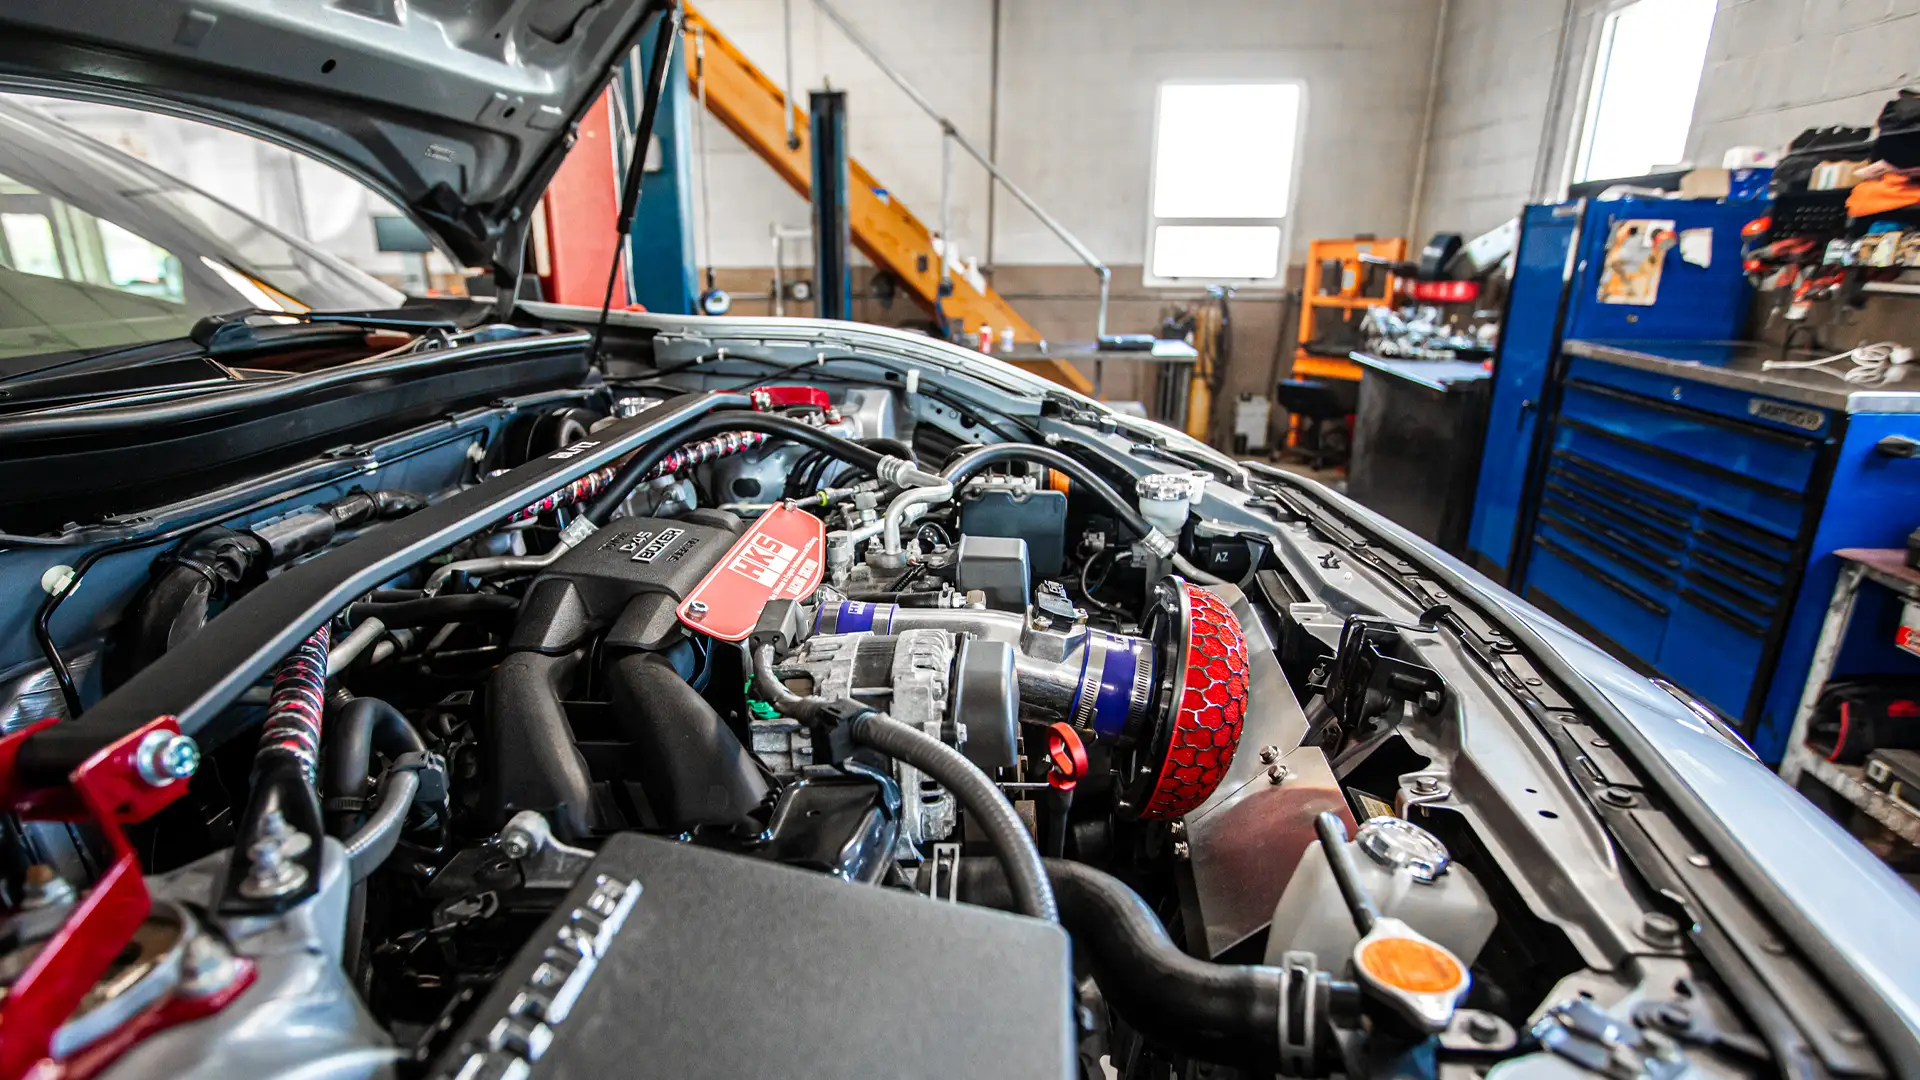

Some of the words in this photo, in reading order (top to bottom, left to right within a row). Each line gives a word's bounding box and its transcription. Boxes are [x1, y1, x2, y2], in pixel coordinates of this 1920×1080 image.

[547, 441, 601, 459] BLITZ
[634, 529, 682, 561] BOXER
[1214, 551, 1229, 563] AZ
[732, 534, 788, 582] HKS
